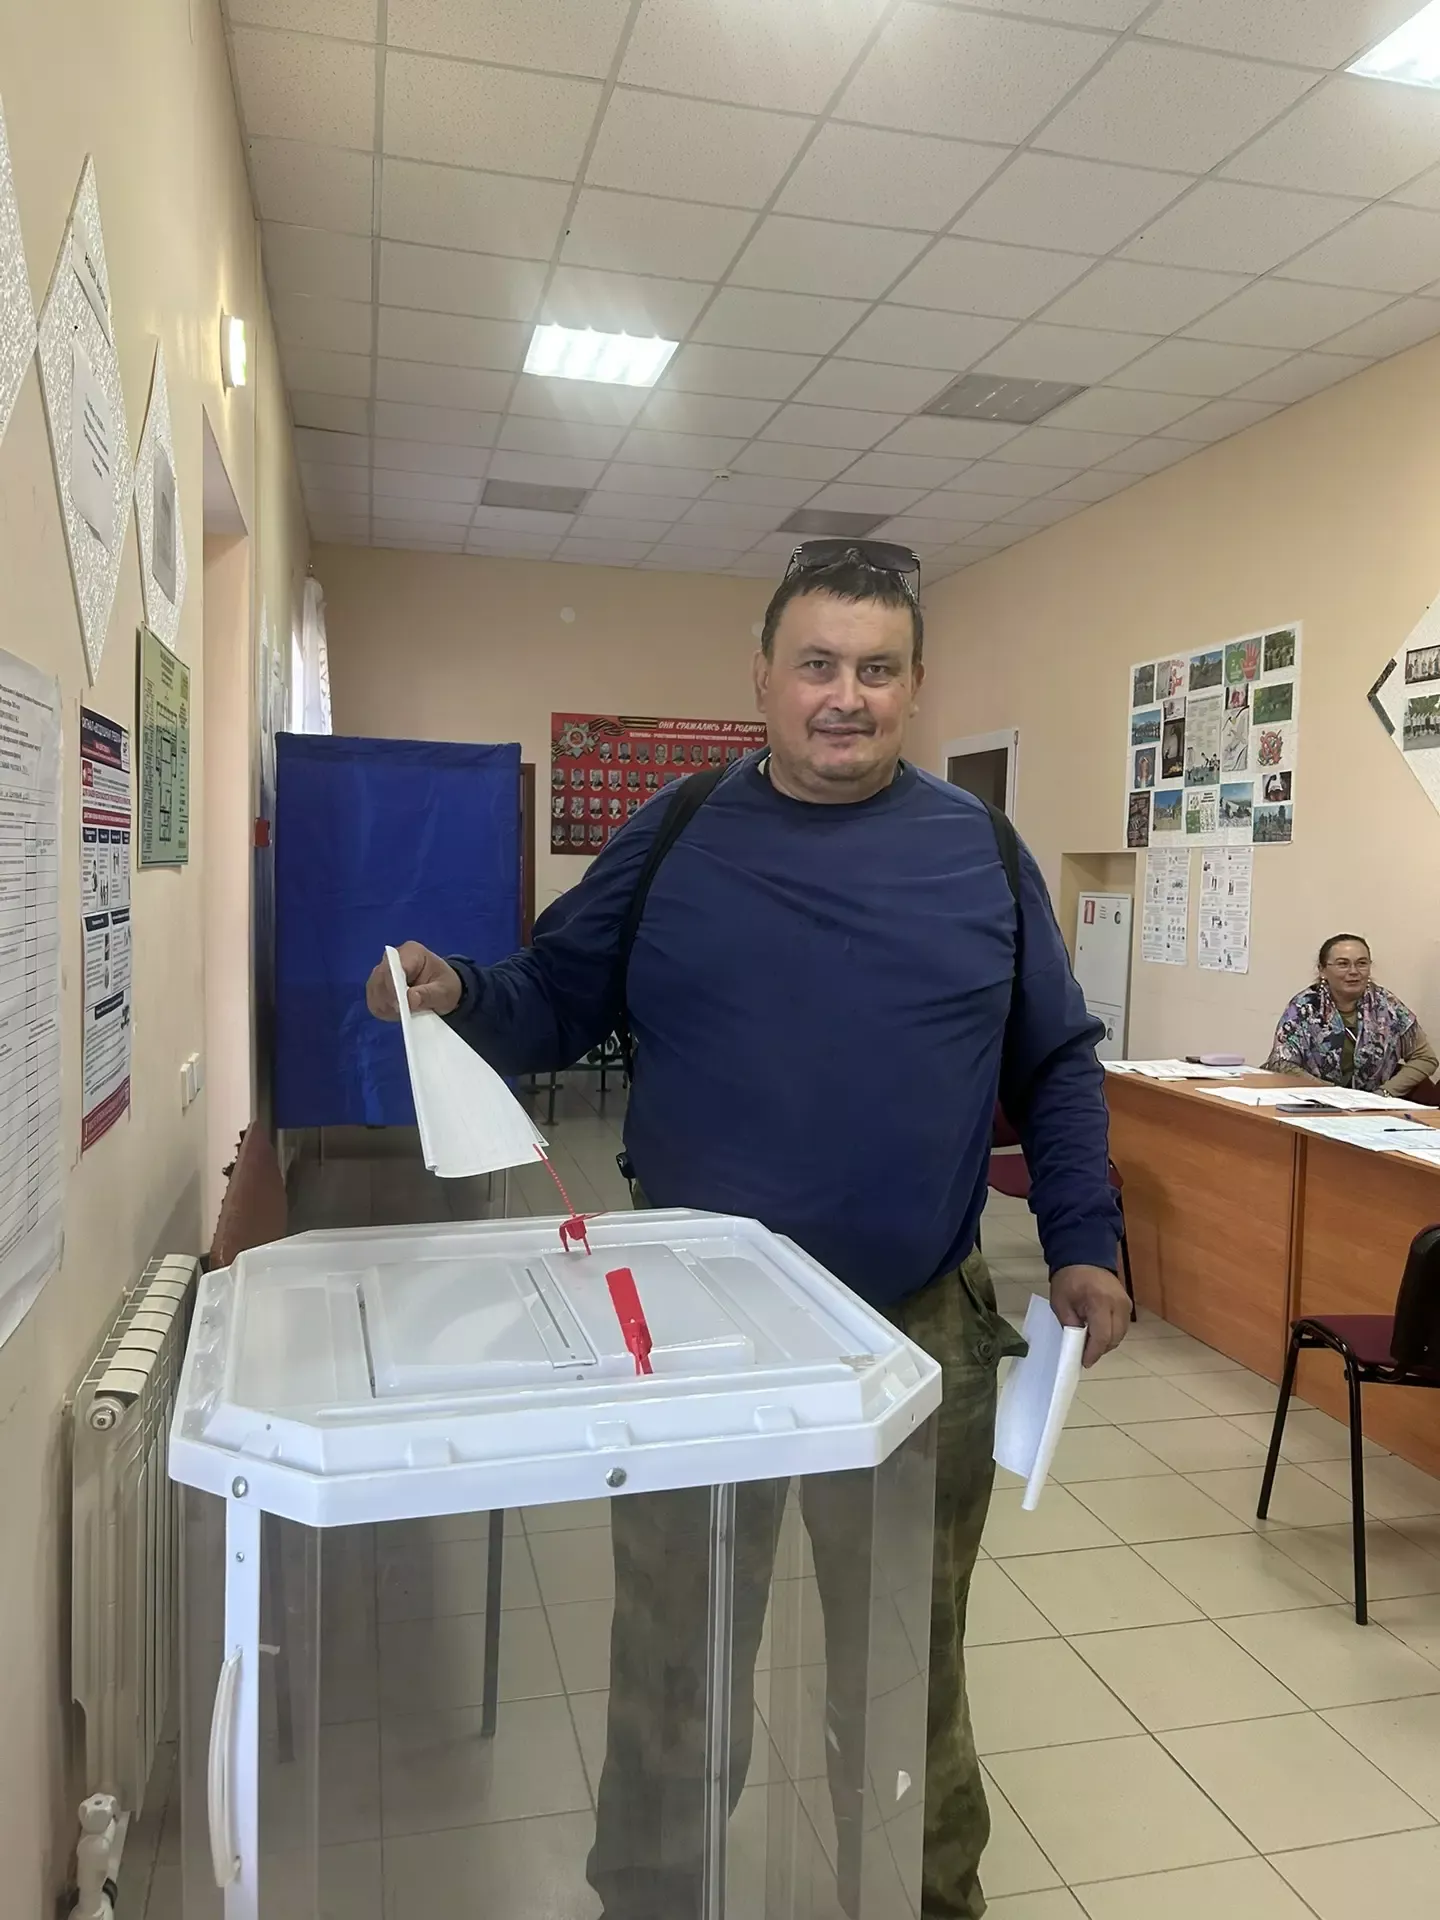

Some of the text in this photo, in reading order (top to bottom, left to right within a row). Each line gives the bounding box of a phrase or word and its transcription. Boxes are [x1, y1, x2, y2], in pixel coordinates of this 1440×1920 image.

[658, 721, 766, 733] ОНИ СРАЖАЛИСЬ ЗА РОДИНУ!
